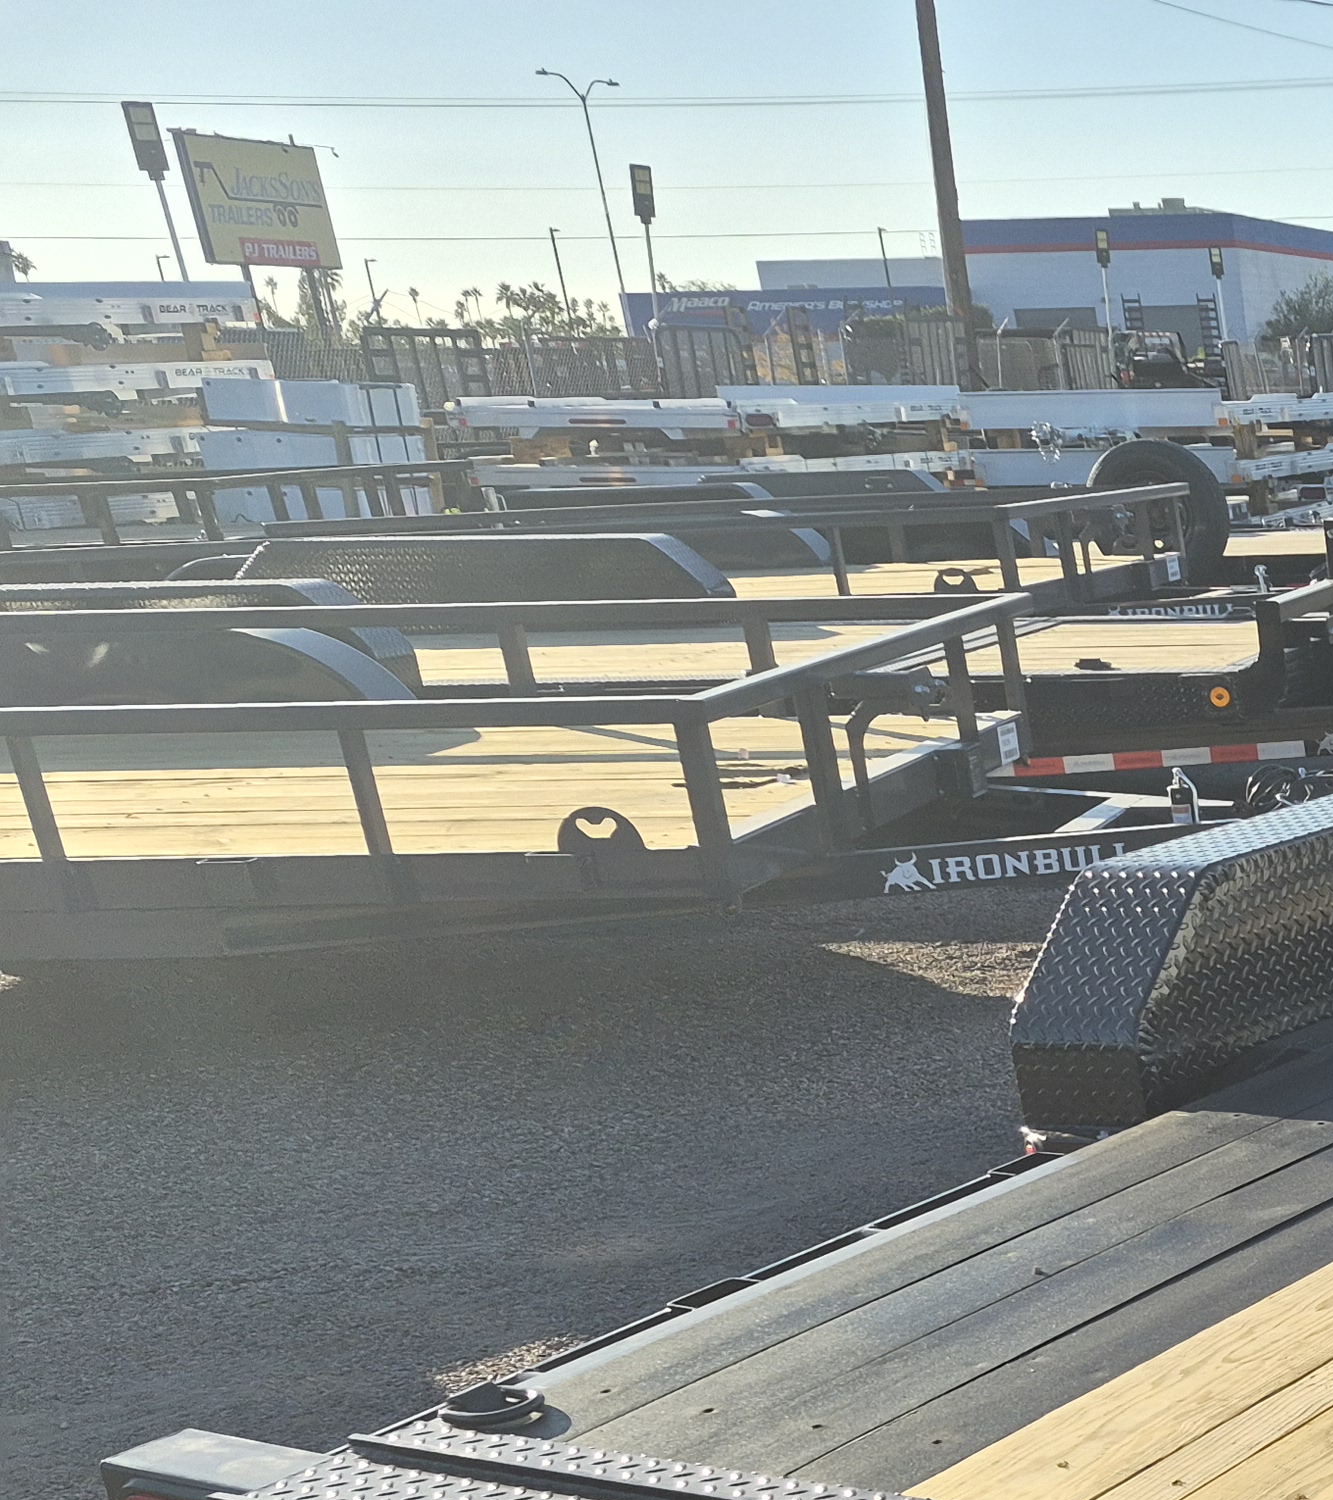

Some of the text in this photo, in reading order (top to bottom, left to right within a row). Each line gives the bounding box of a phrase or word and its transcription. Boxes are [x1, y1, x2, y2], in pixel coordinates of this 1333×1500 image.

[209, 204, 273, 228] TRAILERS
[244, 243, 317, 261] PJ TRAILERS
[159, 304, 227, 313] BEAR TRACK
[667, 297, 729, 312] Maaco
